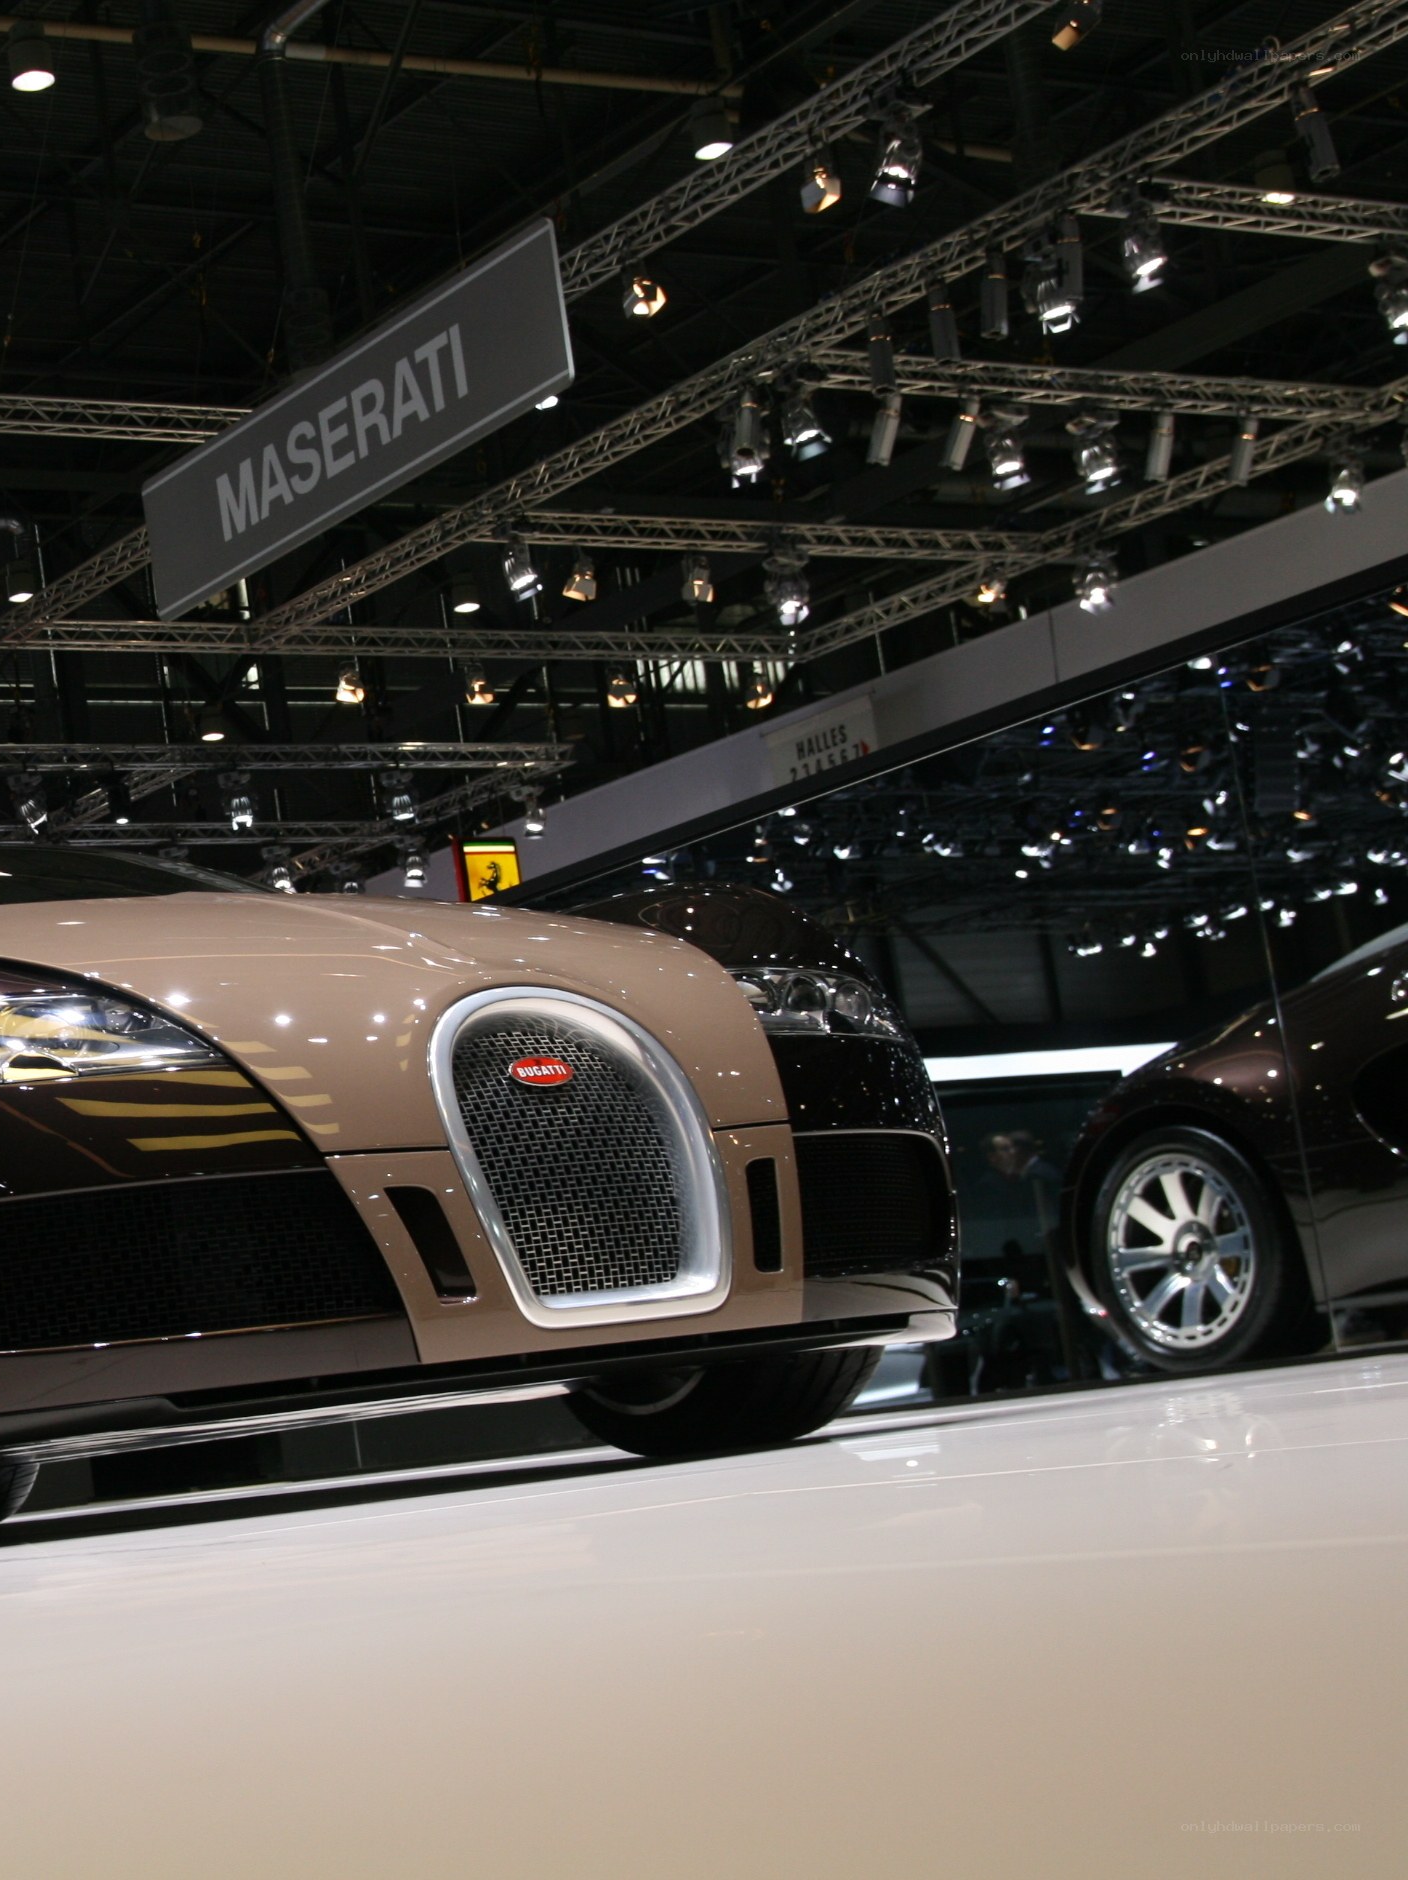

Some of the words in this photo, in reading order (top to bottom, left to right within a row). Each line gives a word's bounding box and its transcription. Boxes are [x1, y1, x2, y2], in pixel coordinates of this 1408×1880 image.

[216, 322, 468, 543] MASERATI
[795, 724, 848, 760] HALLES
[516, 1064, 568, 1078] BUGATTI
